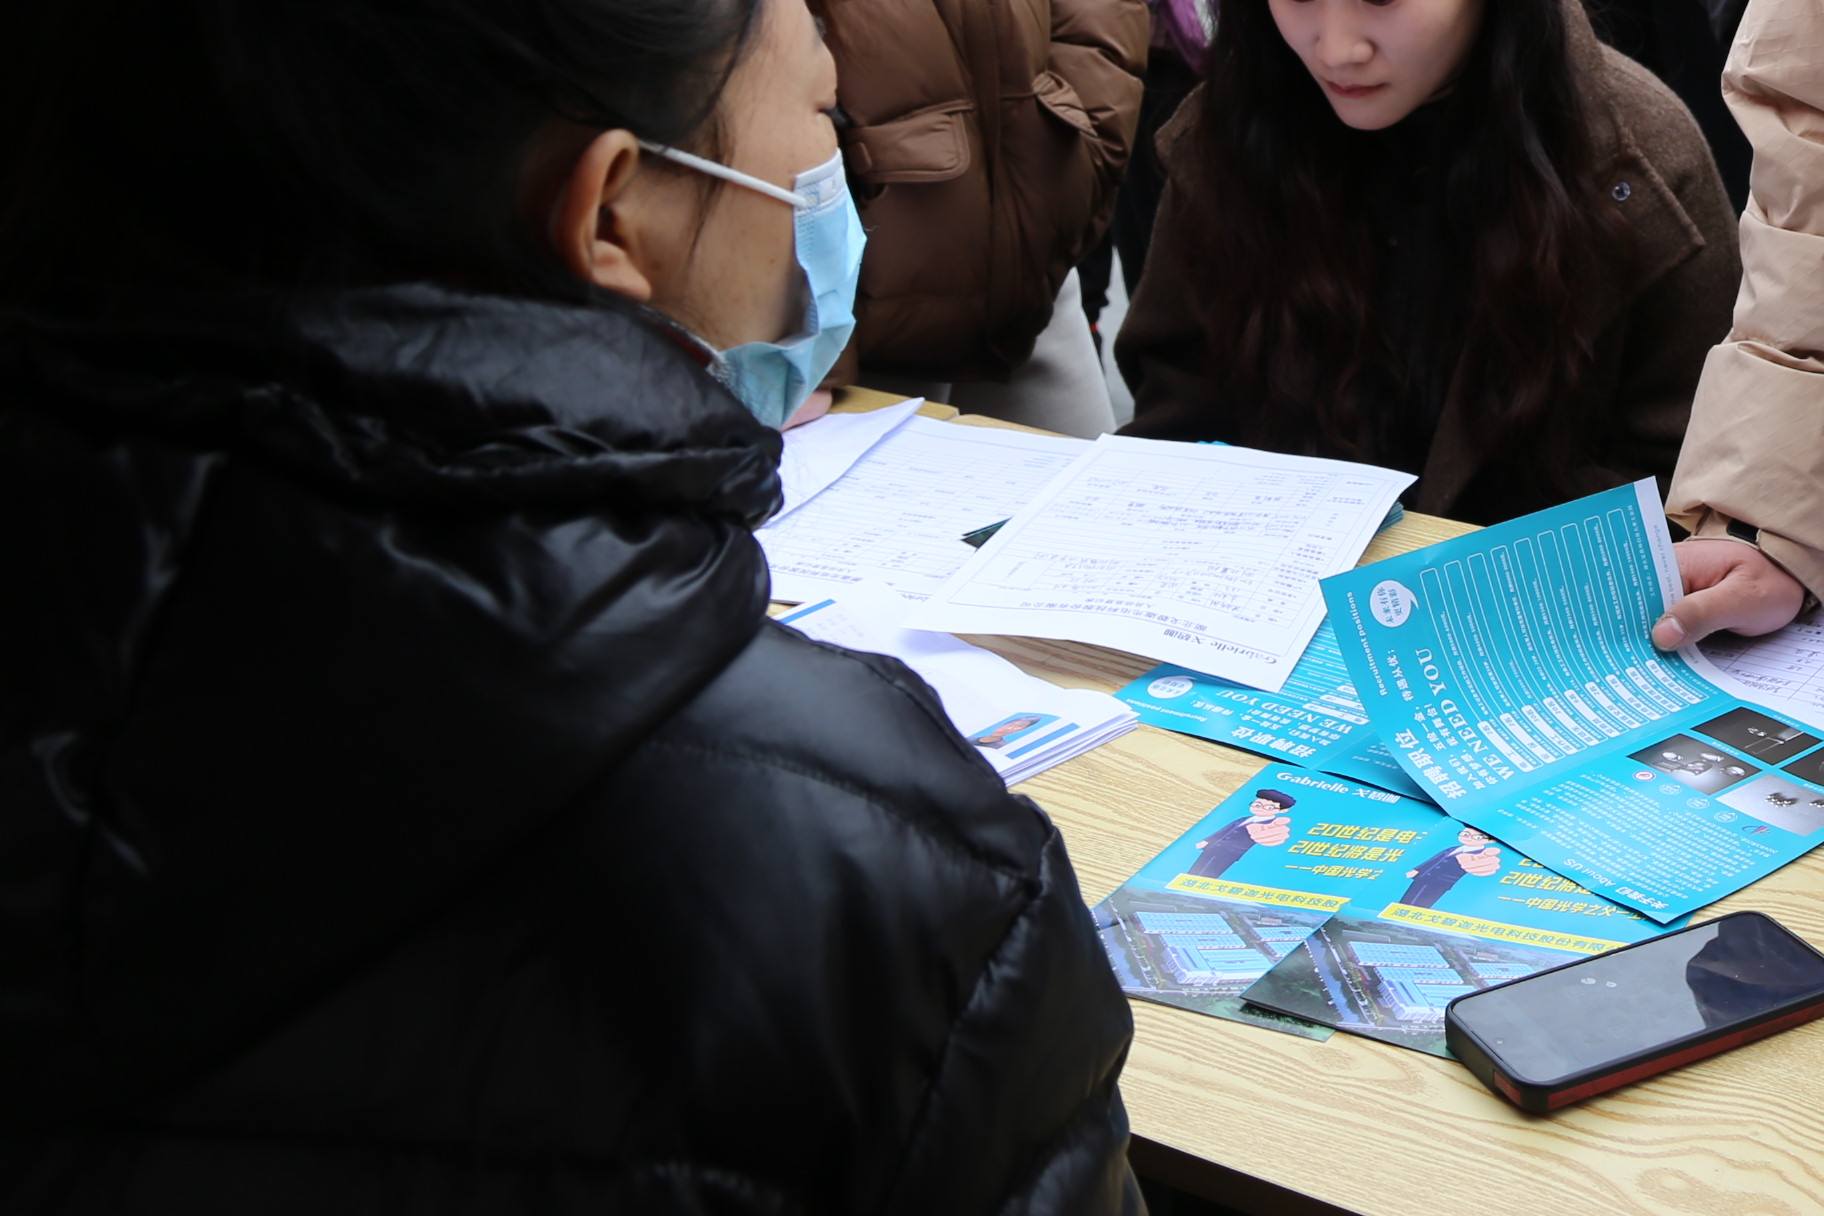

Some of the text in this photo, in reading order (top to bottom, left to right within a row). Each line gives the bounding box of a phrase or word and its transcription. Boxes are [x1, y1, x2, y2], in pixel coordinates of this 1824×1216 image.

[1375, 585, 1395, 624] 未来有你
[1386, 587, 1403, 617] 更精彩
[1344, 591, 1388, 696] Recruitment positions
[1215, 686, 1352, 736] WE NEED YOU
[1414, 646, 1515, 780] WE NEED YOU
[1230, 723, 1315, 759] 招聘职位
[1392, 727, 1466, 799] 招聘职位
[1276, 771, 1349, 794] Gabrielle
[1563, 856, 1583, 871] US
[1580, 865, 1616, 887] About
[1615, 884, 1668, 910] 关于我们
